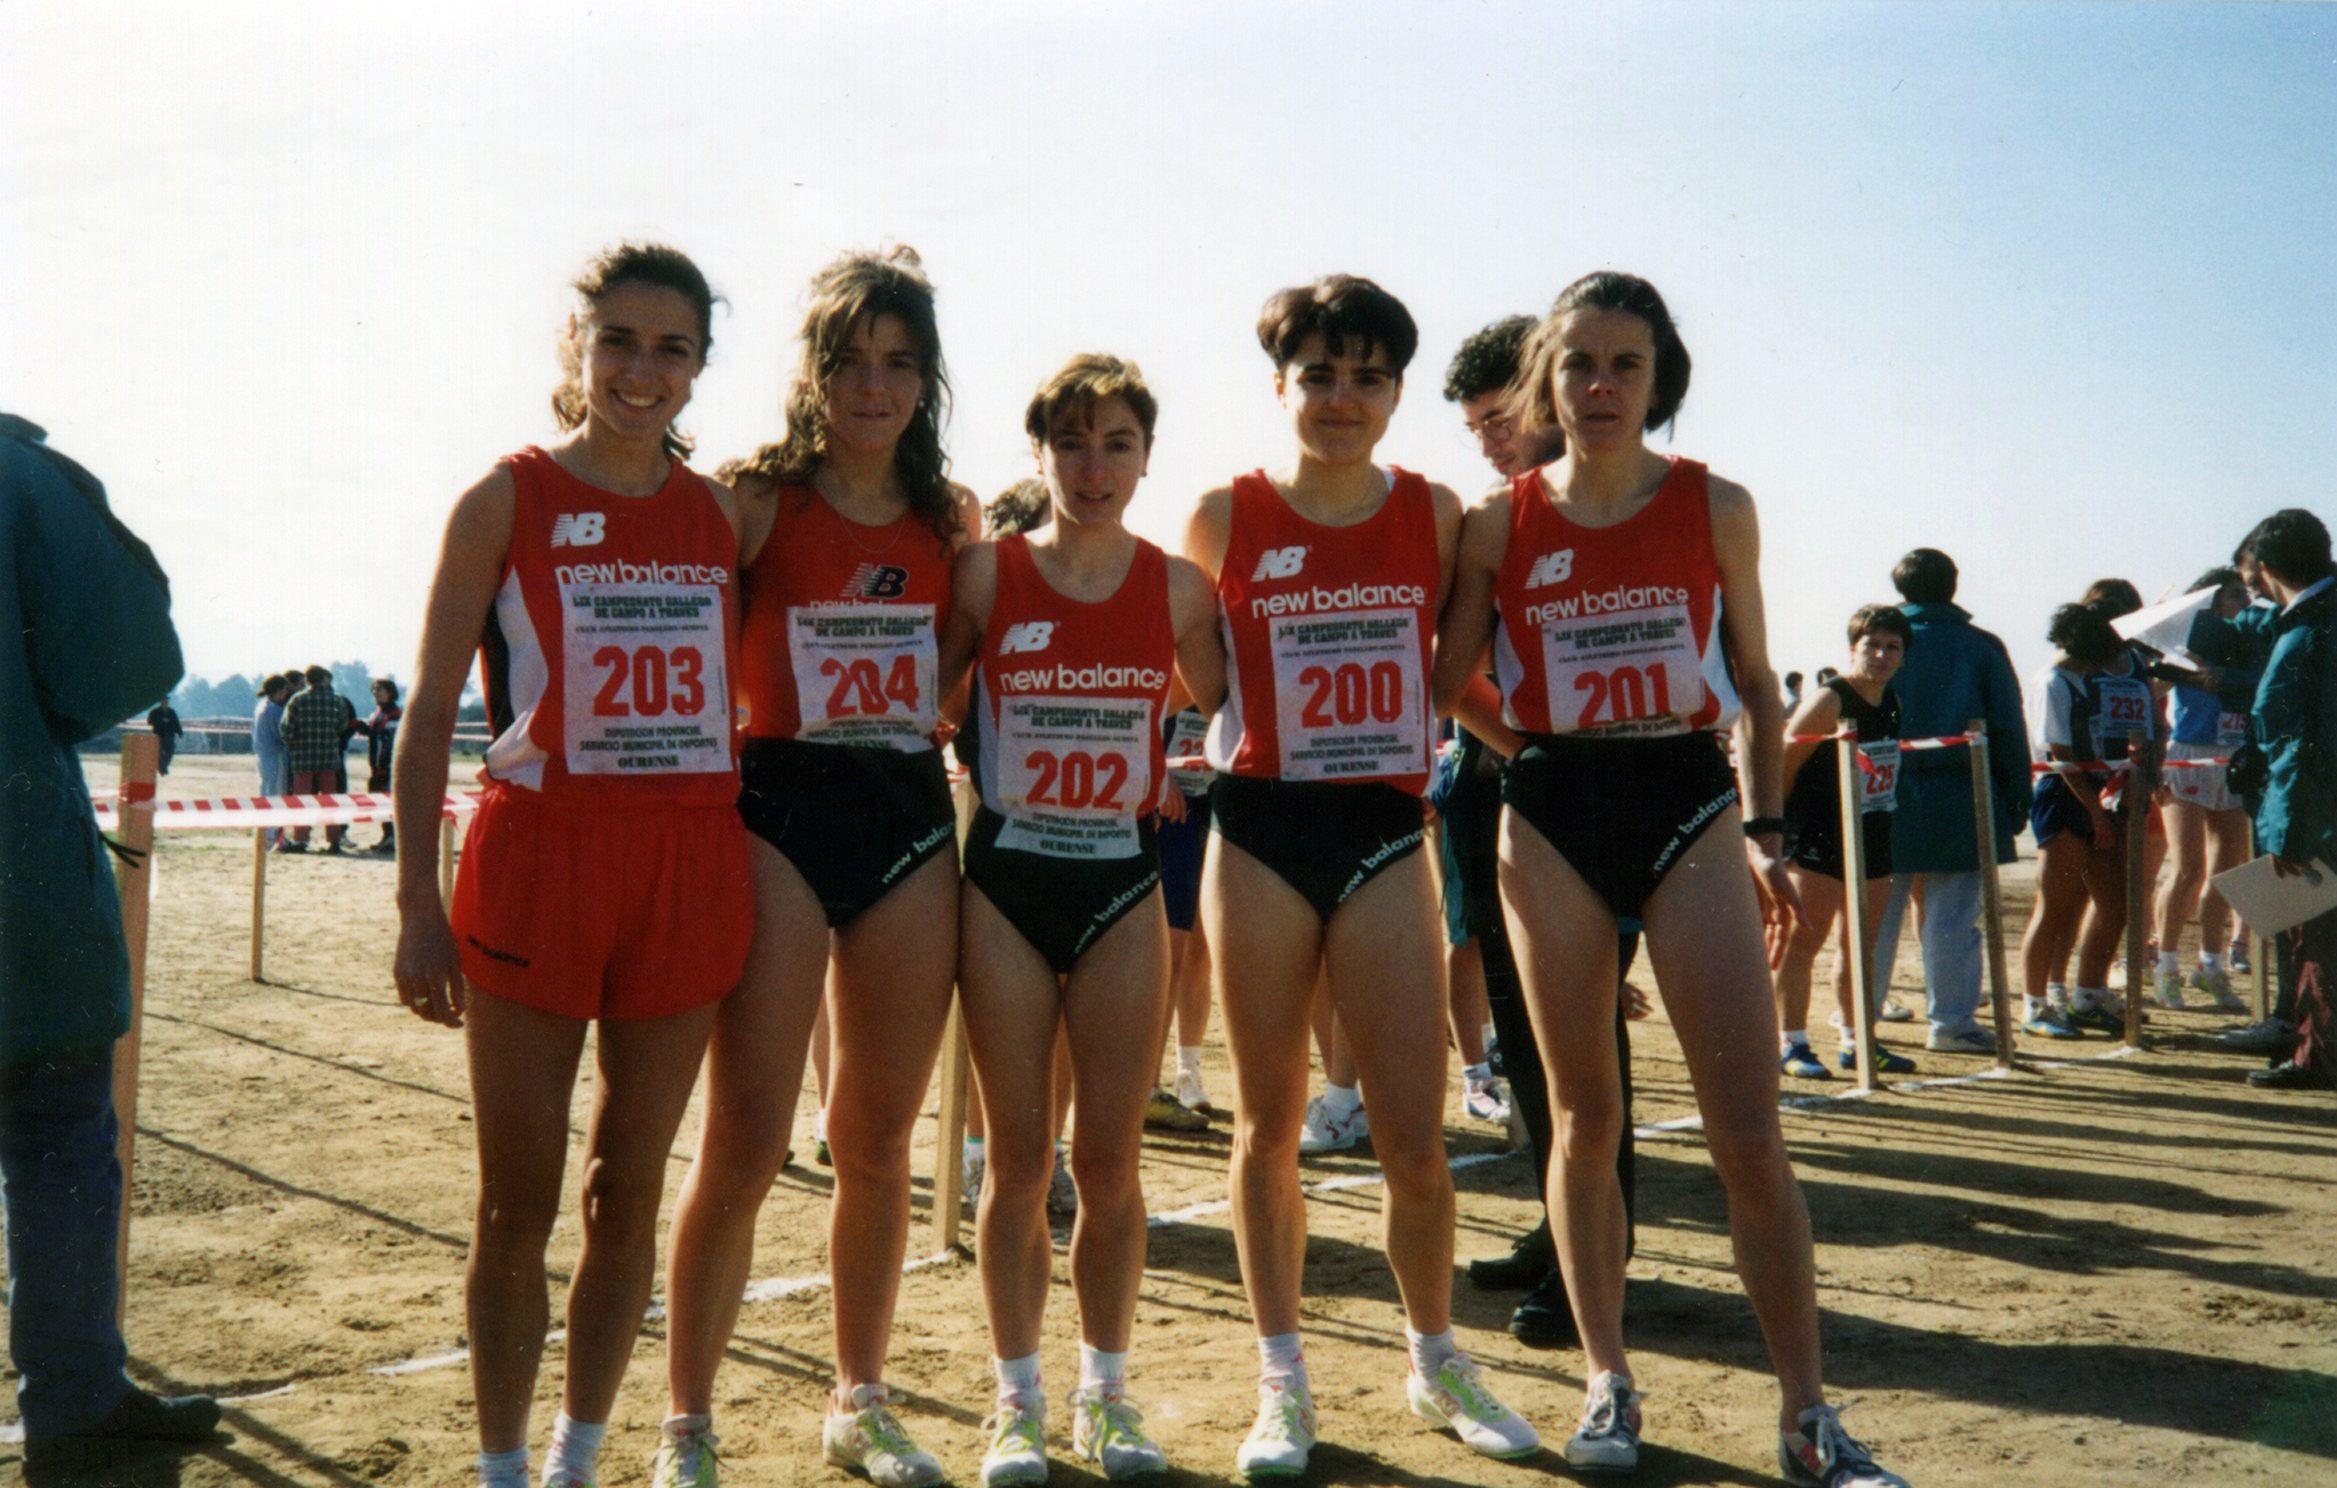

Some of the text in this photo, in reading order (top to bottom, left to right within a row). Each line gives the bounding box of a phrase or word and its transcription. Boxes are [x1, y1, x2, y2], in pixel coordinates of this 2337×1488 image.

[551, 511, 606, 547] NB
[554, 558, 728, 584] new balance
[839, 562, 910, 599] NB
[1250, 545, 1307, 582] NB
[1524, 548, 1575, 590] NB
[611, 607, 646, 618] CAMPO
[1252, 582, 1425, 619] new balance
[1525, 584, 1689, 626] new balance
[998, 621, 1054, 656] NB
[592, 645, 705, 717] 203
[819, 654, 920, 720] 204
[1000, 662, 1166, 692] new balance
[1298, 660, 1403, 729] 200
[1574, 661, 1670, 729] 201
[1050, 717, 1083, 728] CAMPO
[617, 755, 679, 768] OURENSE
[1323, 760, 1379, 774] OURENSE
[1025, 750, 1128, 811] 202
[1040, 840, 1097, 854] OURENSE
[1654, 836, 1680, 872] new
[881, 852, 912, 884] new
[1094, 871, 1159, 922] balance
